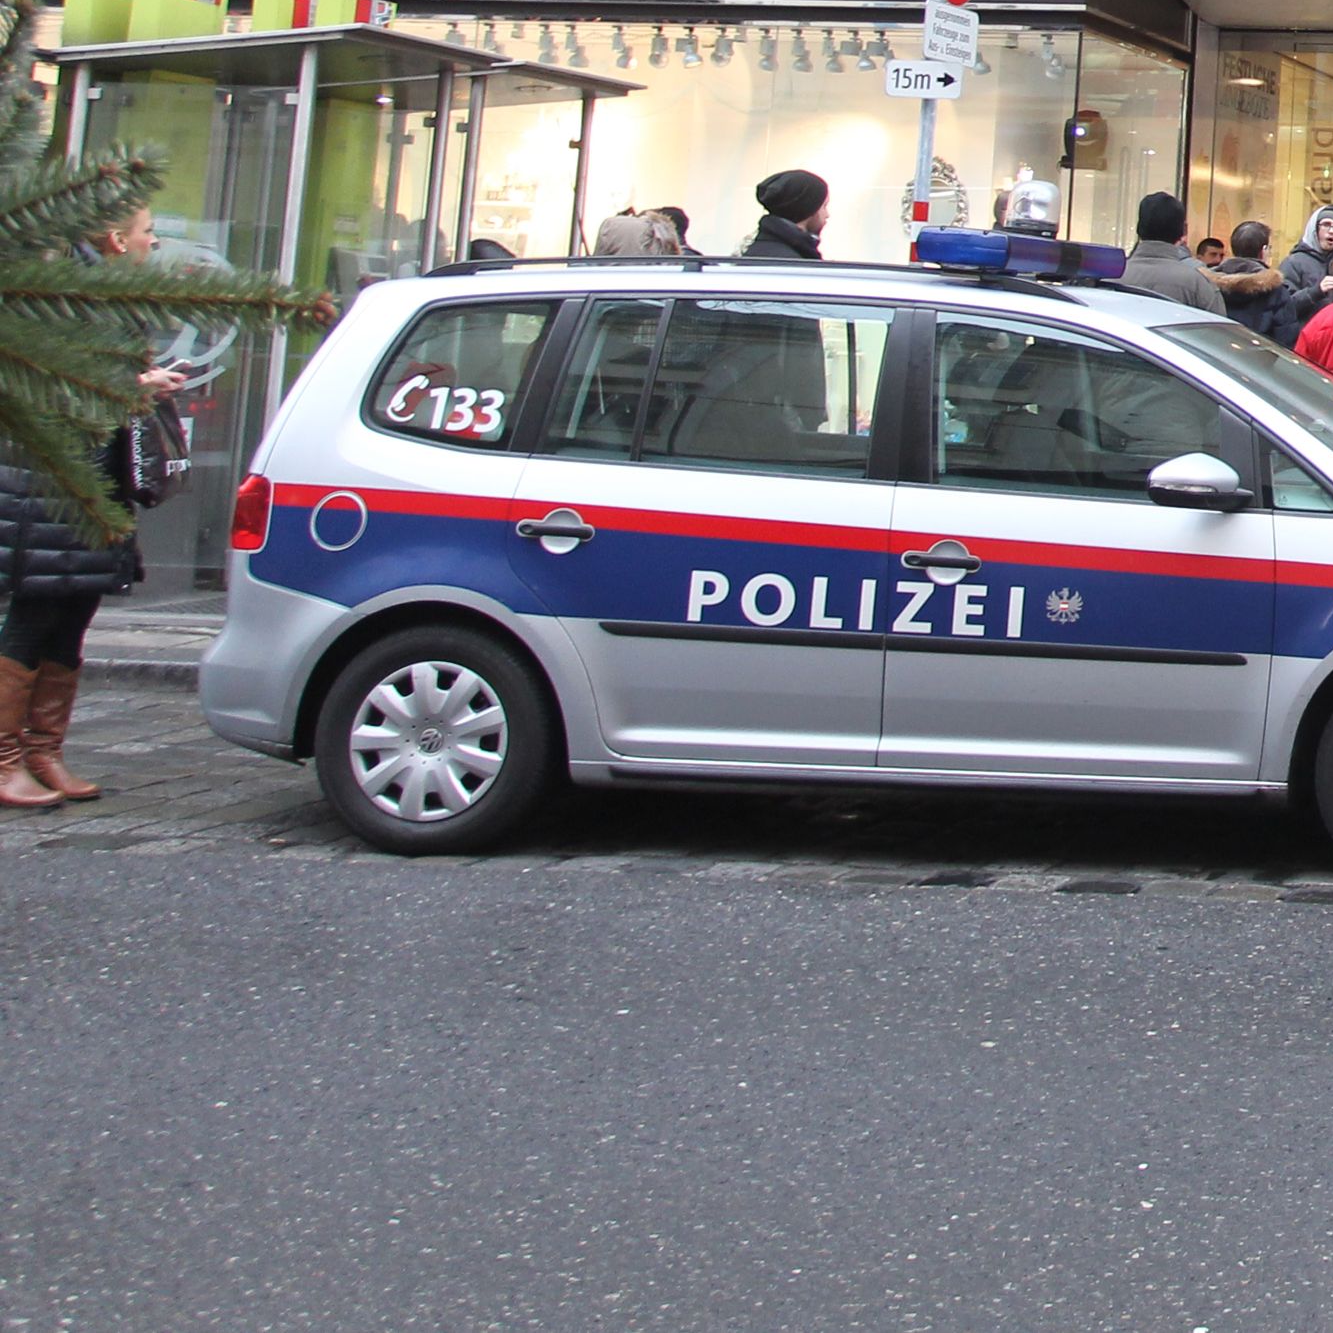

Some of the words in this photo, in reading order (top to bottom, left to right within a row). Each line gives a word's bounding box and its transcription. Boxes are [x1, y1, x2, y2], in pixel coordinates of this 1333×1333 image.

[892, 67, 932, 90] 15m
[430, 387, 505, 433] 133
[687, 570, 1025, 638] POLIZEI
